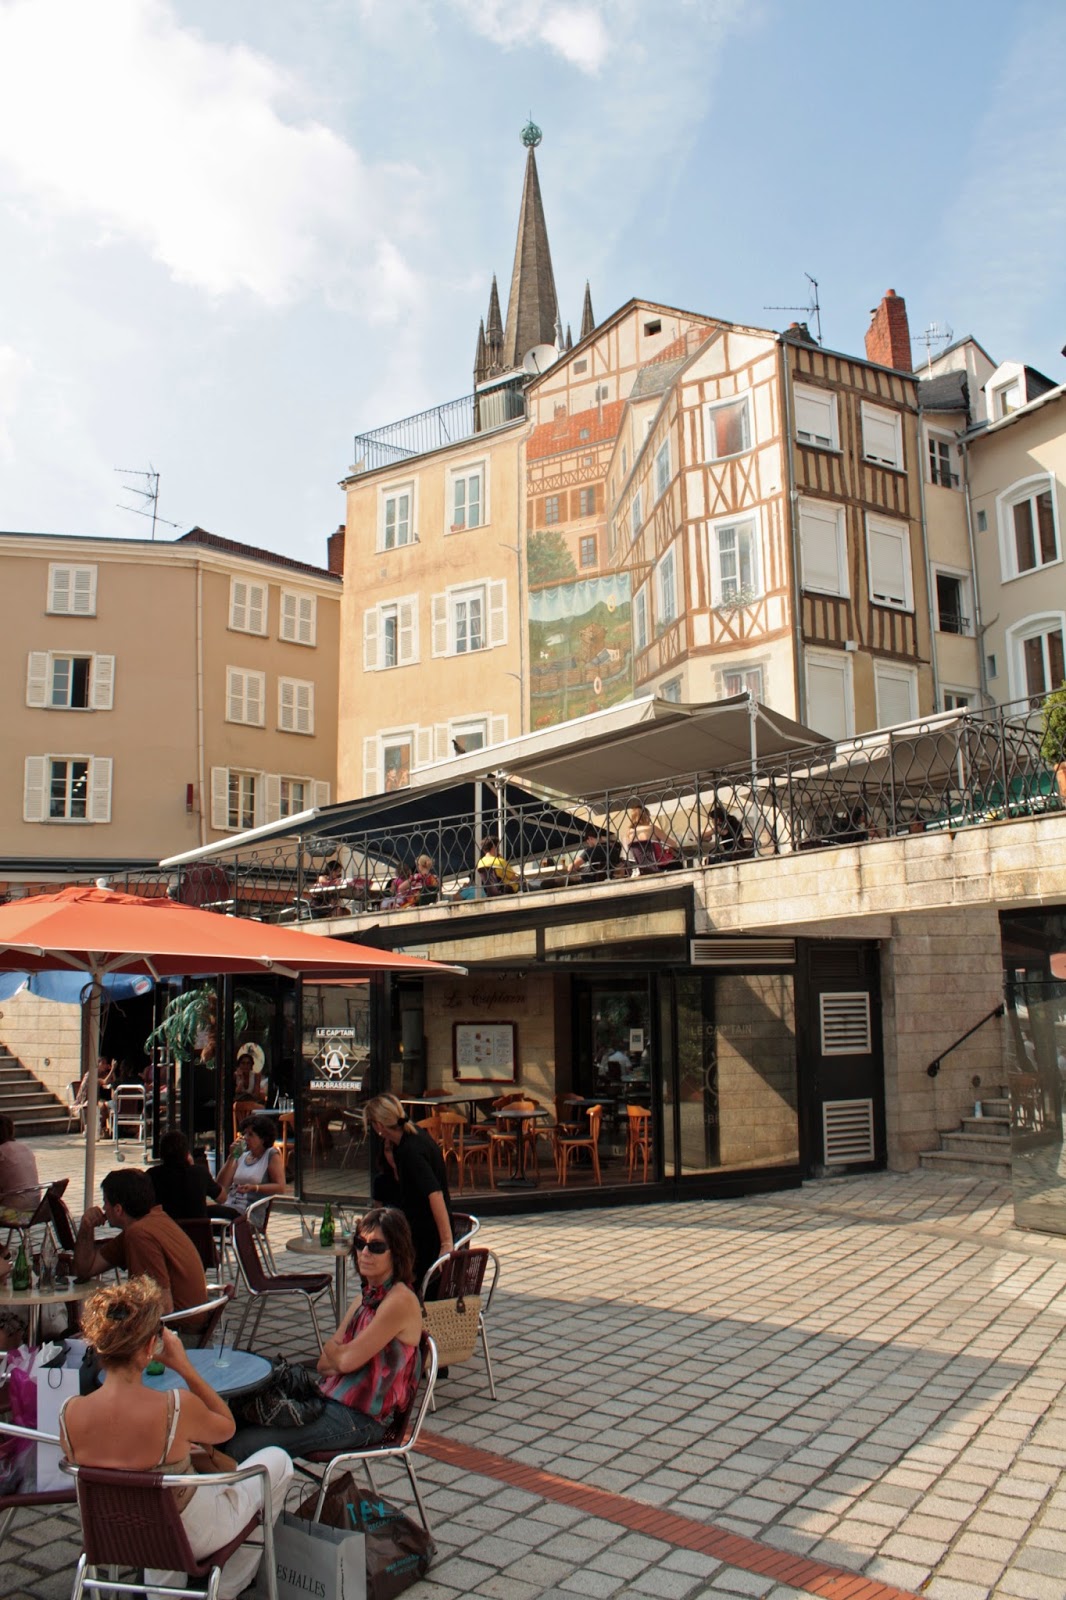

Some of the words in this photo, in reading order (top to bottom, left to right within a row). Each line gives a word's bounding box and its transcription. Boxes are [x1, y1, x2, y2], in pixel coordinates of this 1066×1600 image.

[690, 1025, 703, 1036] LE
[311, 1081, 360, 1090] BAR-BRASSERIE
[276, 1563, 288, 1581] ES
[288, 1569, 326, 1598] HALLES
